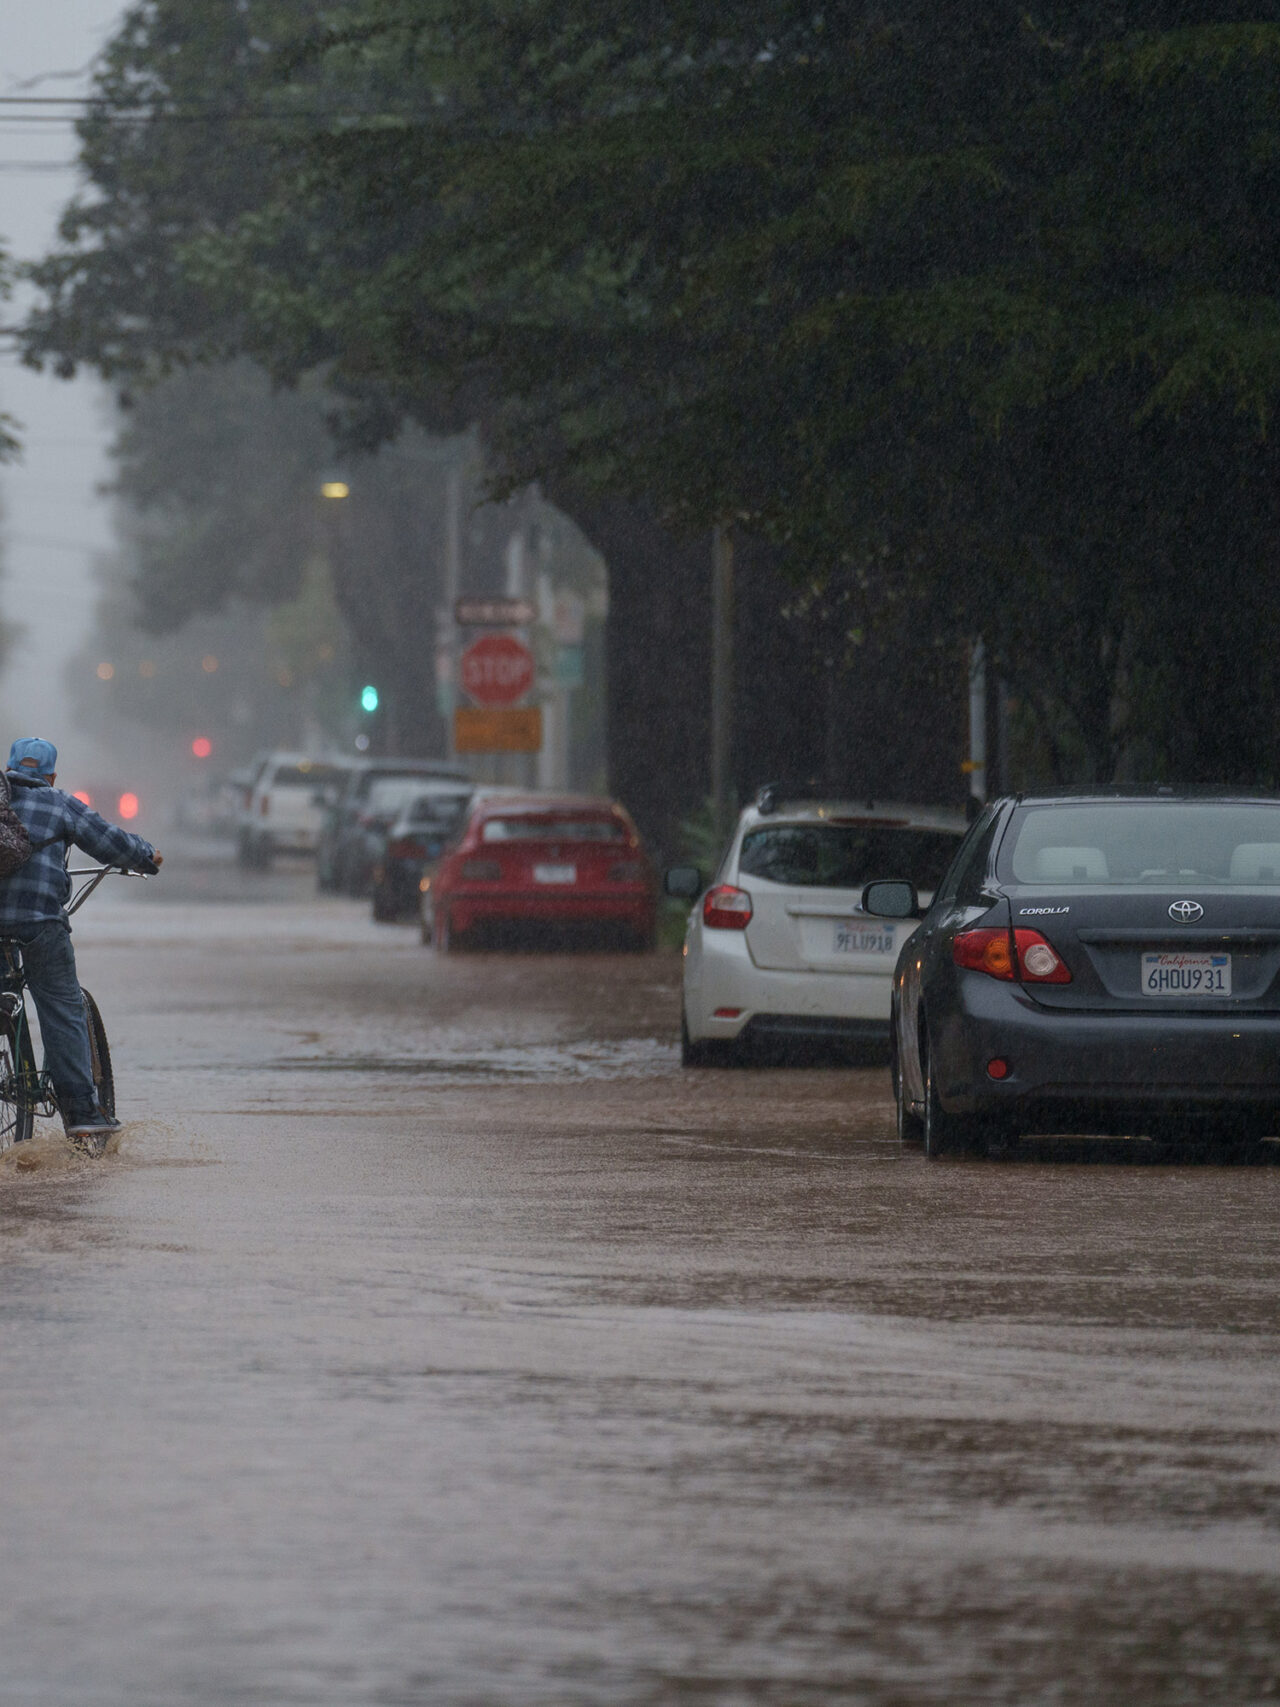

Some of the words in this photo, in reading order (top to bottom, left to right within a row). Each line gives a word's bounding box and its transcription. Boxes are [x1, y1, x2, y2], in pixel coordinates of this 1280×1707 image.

[467, 656, 528, 685] STOP
[1019, 906, 1070, 915] COROLLA
[1160, 955, 1211, 968] California
